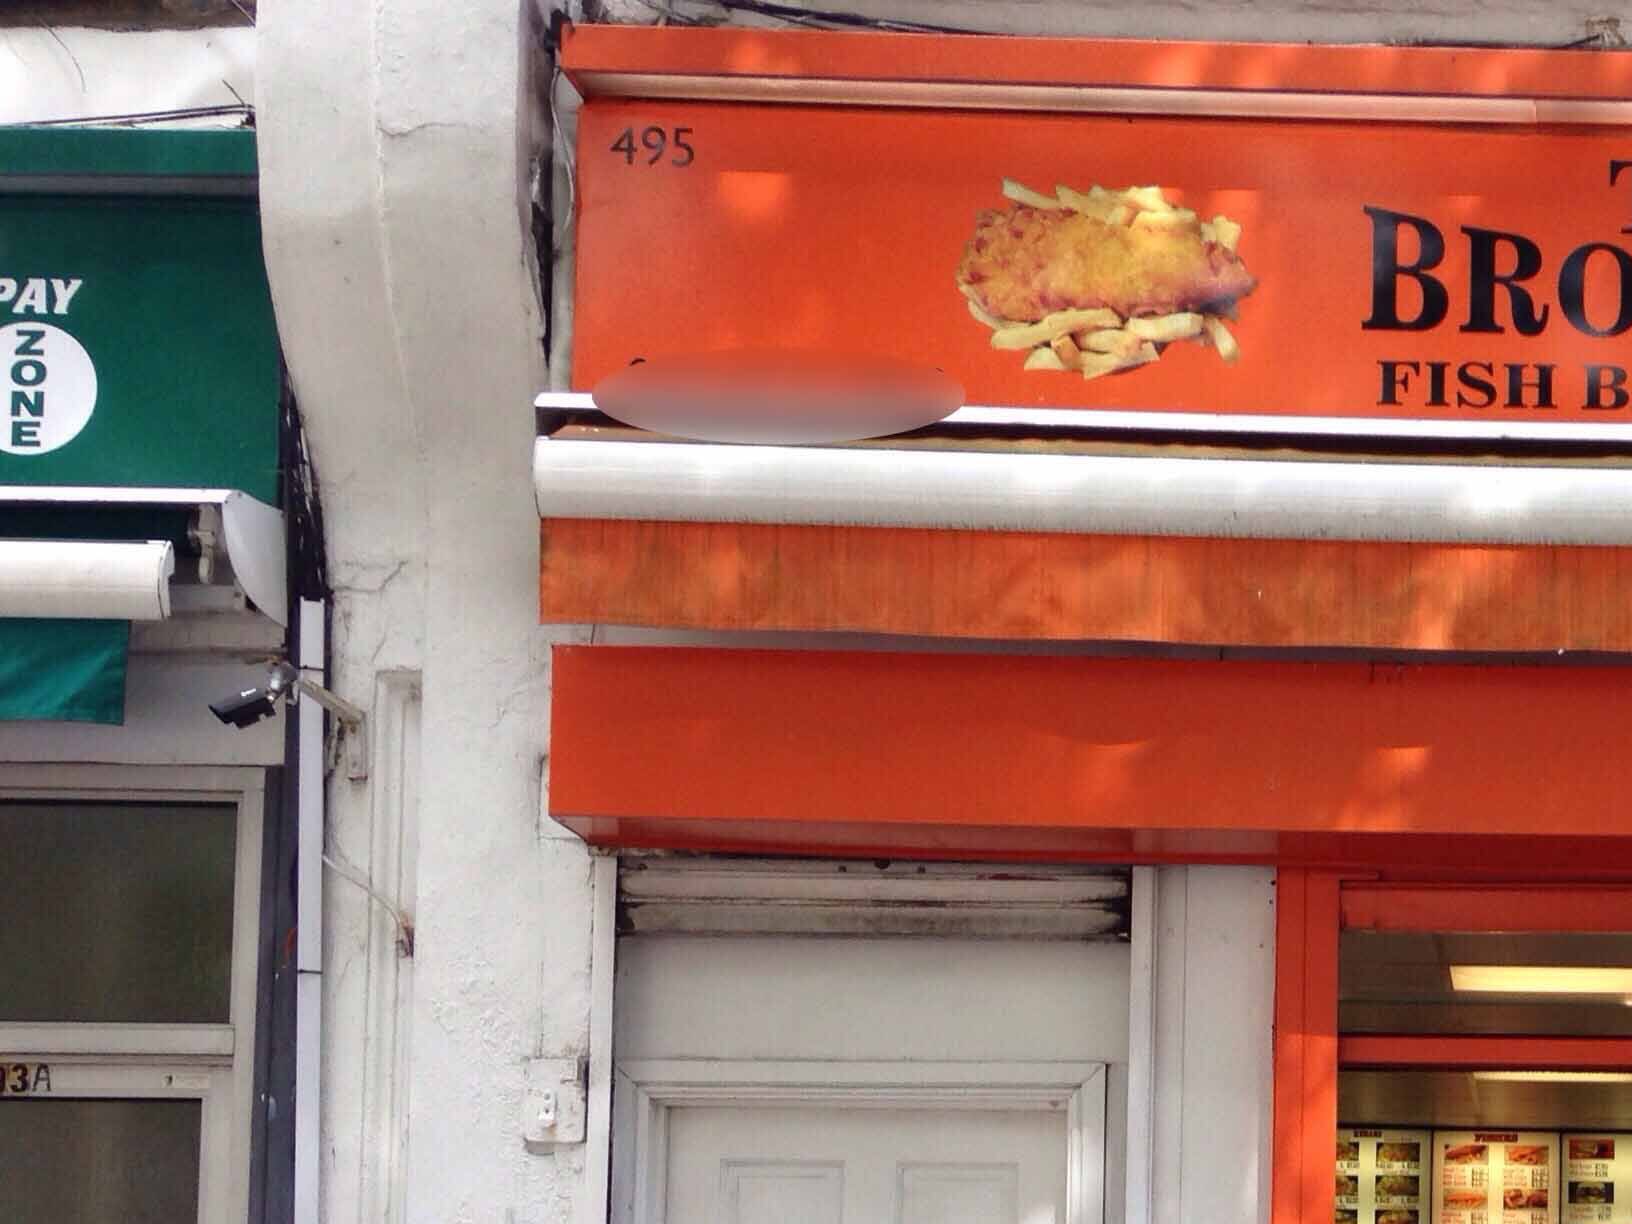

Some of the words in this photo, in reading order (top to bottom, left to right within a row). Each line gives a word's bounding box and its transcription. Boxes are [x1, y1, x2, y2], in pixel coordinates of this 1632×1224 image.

[609, 126, 696, 169] 495
[0, 277, 83, 314] PAY
[10, 329, 47, 447] ZONE
[1376, 360, 1557, 410] FISH
